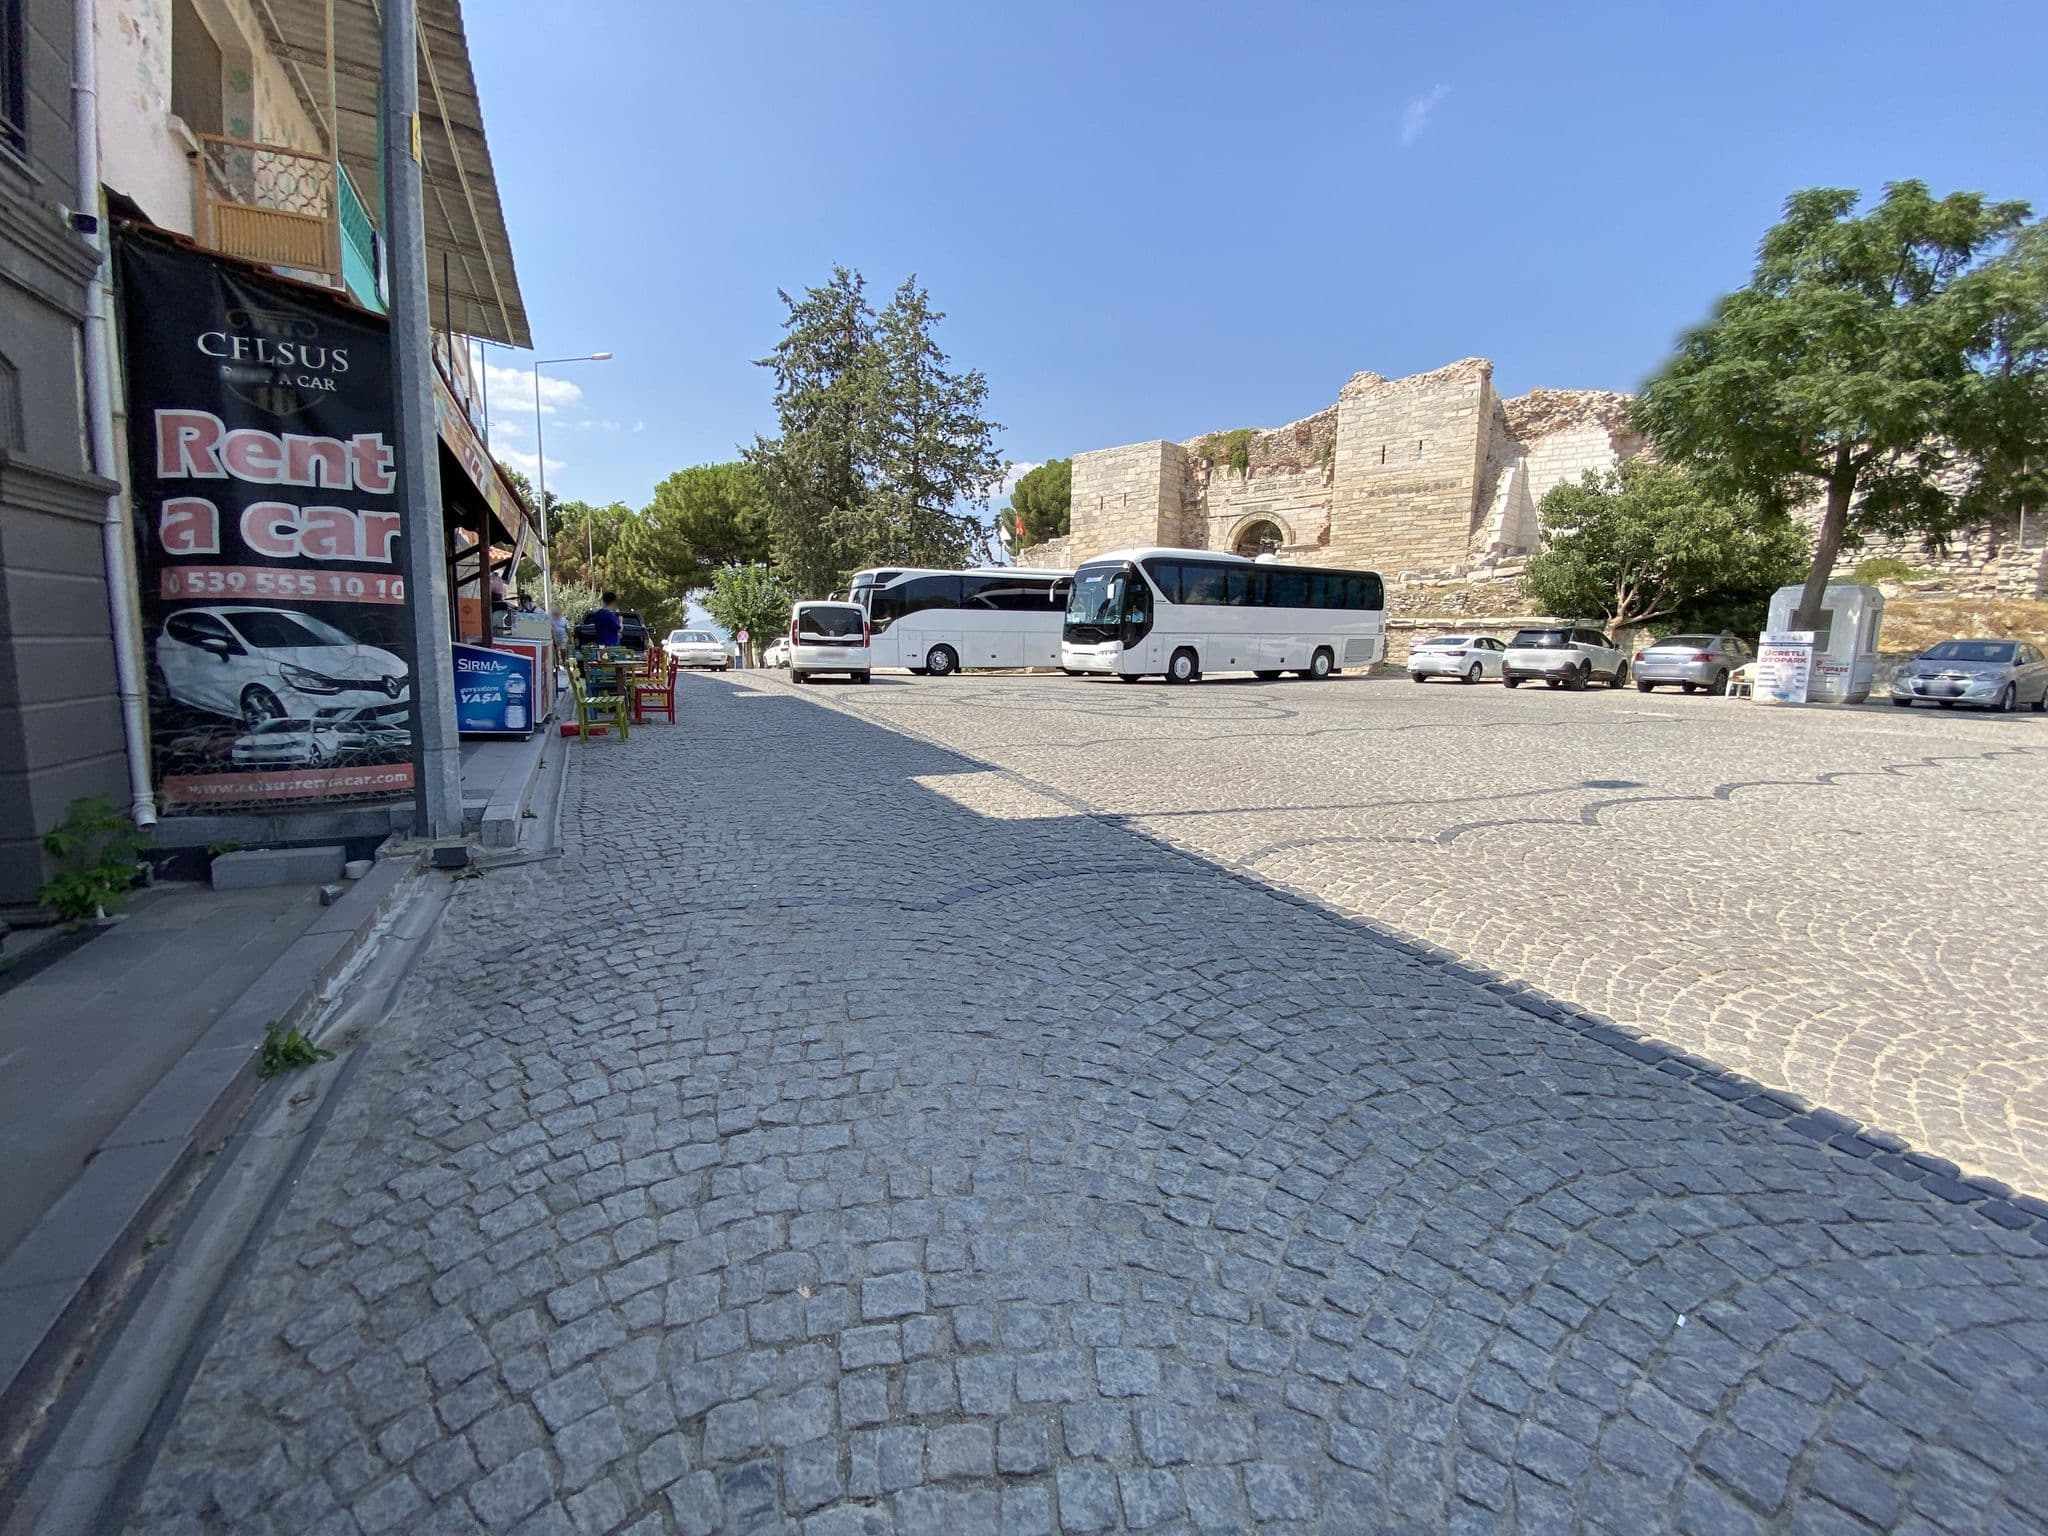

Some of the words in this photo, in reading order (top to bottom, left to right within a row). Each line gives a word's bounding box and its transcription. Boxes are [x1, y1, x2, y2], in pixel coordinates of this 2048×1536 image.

[297, 375, 337, 391] CAR
[154, 409, 397, 494] Rent
[159, 497, 220, 555] a
[239, 501, 402, 563] car
[187, 572, 246, 594] 539
[256, 573, 316, 595] 555
[330, 577, 364, 597] 10
[376, 579, 405, 599] 10
[458, 658, 502, 671] SIRMA
[460, 692, 502, 704] YAŞA
